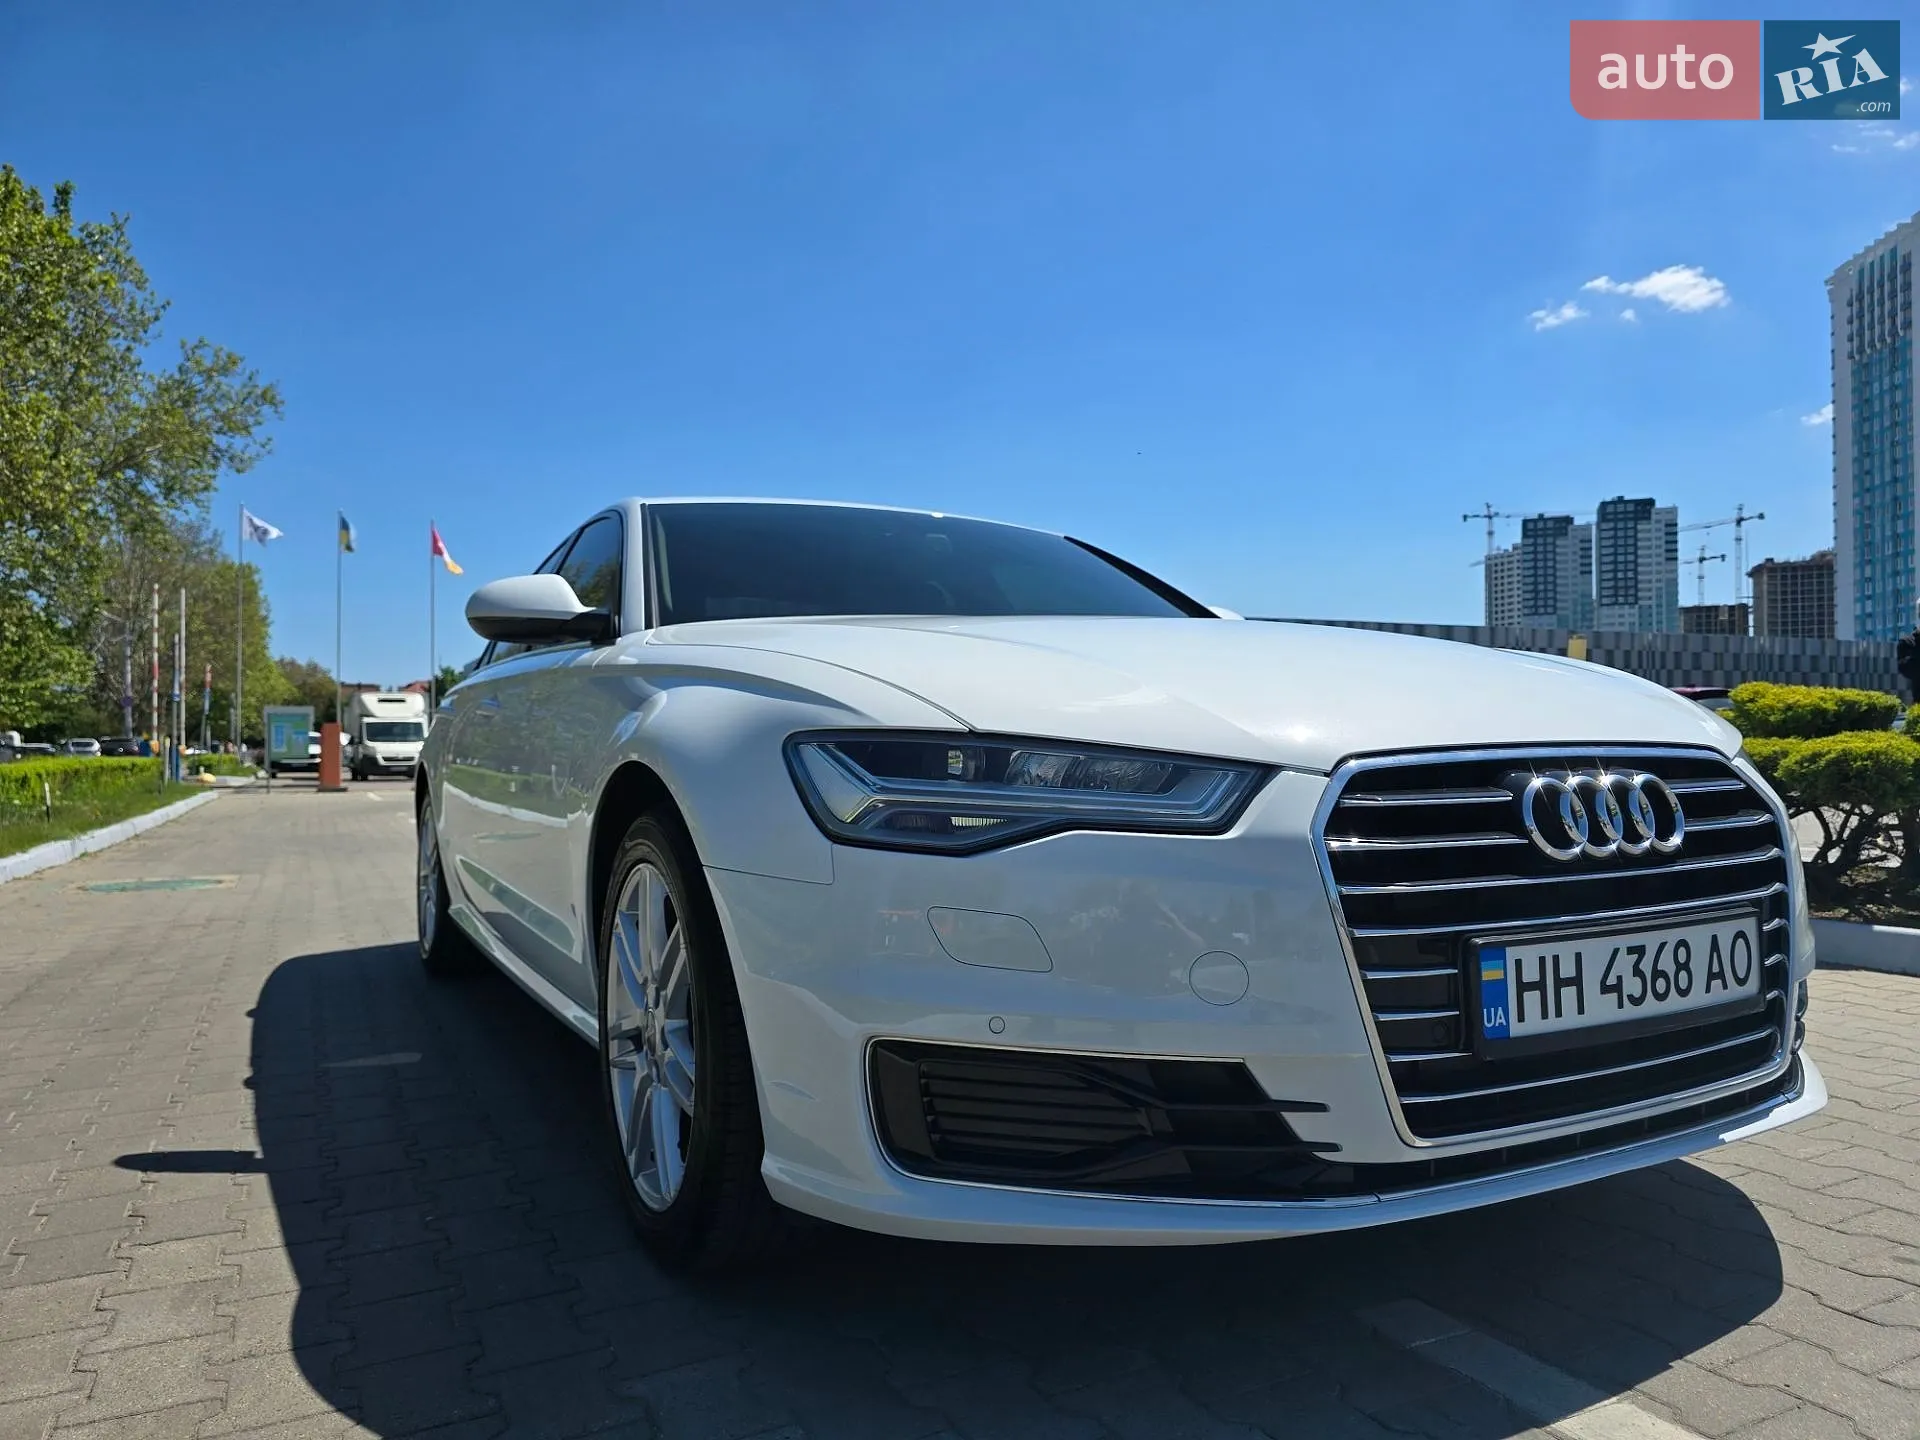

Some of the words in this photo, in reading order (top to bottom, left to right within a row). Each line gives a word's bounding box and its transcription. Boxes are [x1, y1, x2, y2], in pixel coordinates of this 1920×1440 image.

[1515, 951, 1585, 1023] HH
[1599, 938, 1694, 1010] 4368
[1704, 930, 1753, 995] AO
[1483, 1006, 1507, 1028] UA
